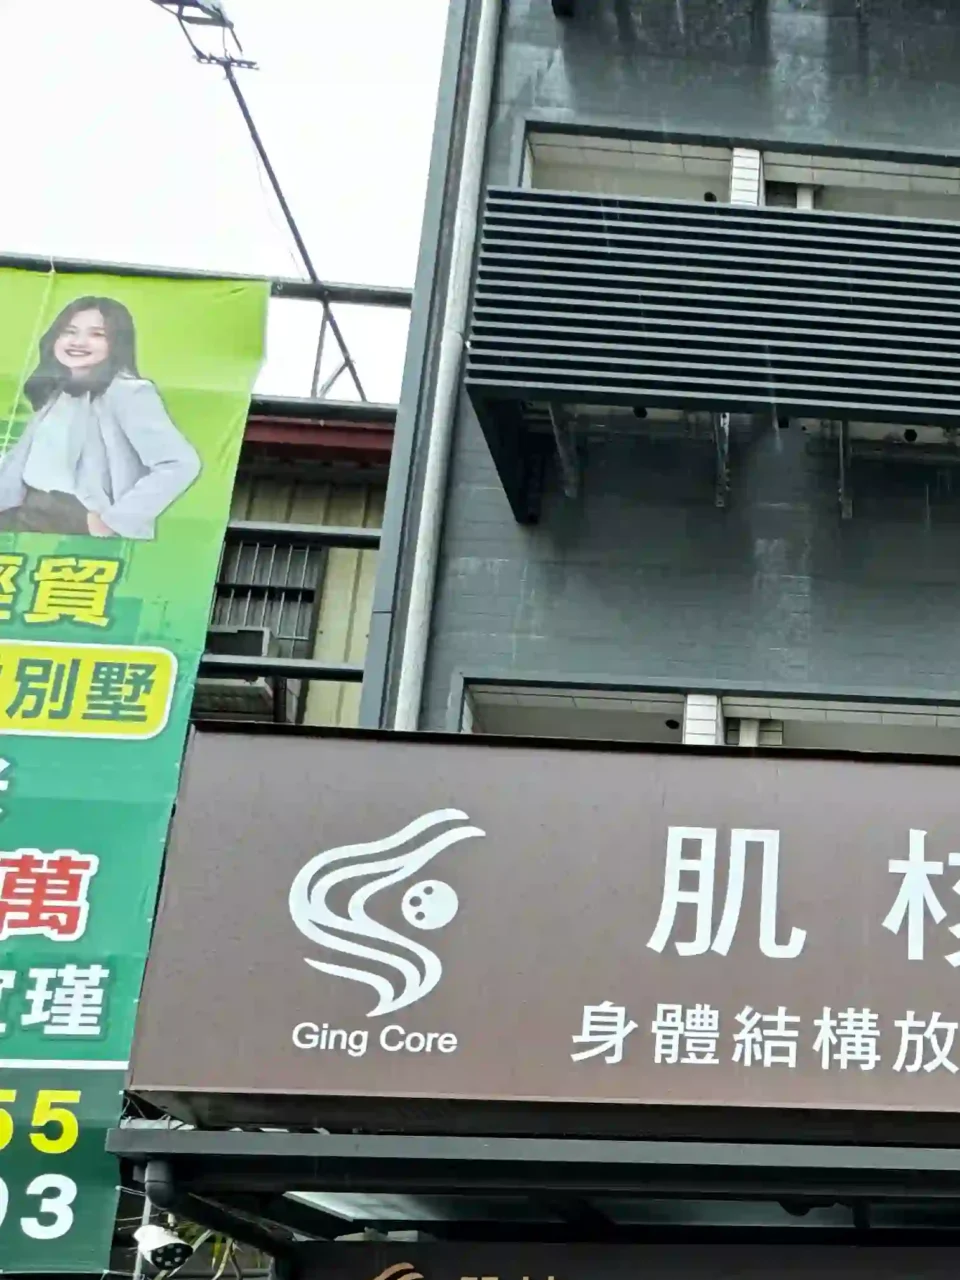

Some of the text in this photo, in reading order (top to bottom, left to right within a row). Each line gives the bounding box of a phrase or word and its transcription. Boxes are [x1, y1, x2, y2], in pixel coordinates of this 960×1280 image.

[0, 657, 158, 722] 別墅
[0, 848, 91, 935] 萬
[0, 964, 110, 1036] 瑾
[291, 1021, 459, 1057] Ging Core
[0, 1173, 78, 1240] 3
